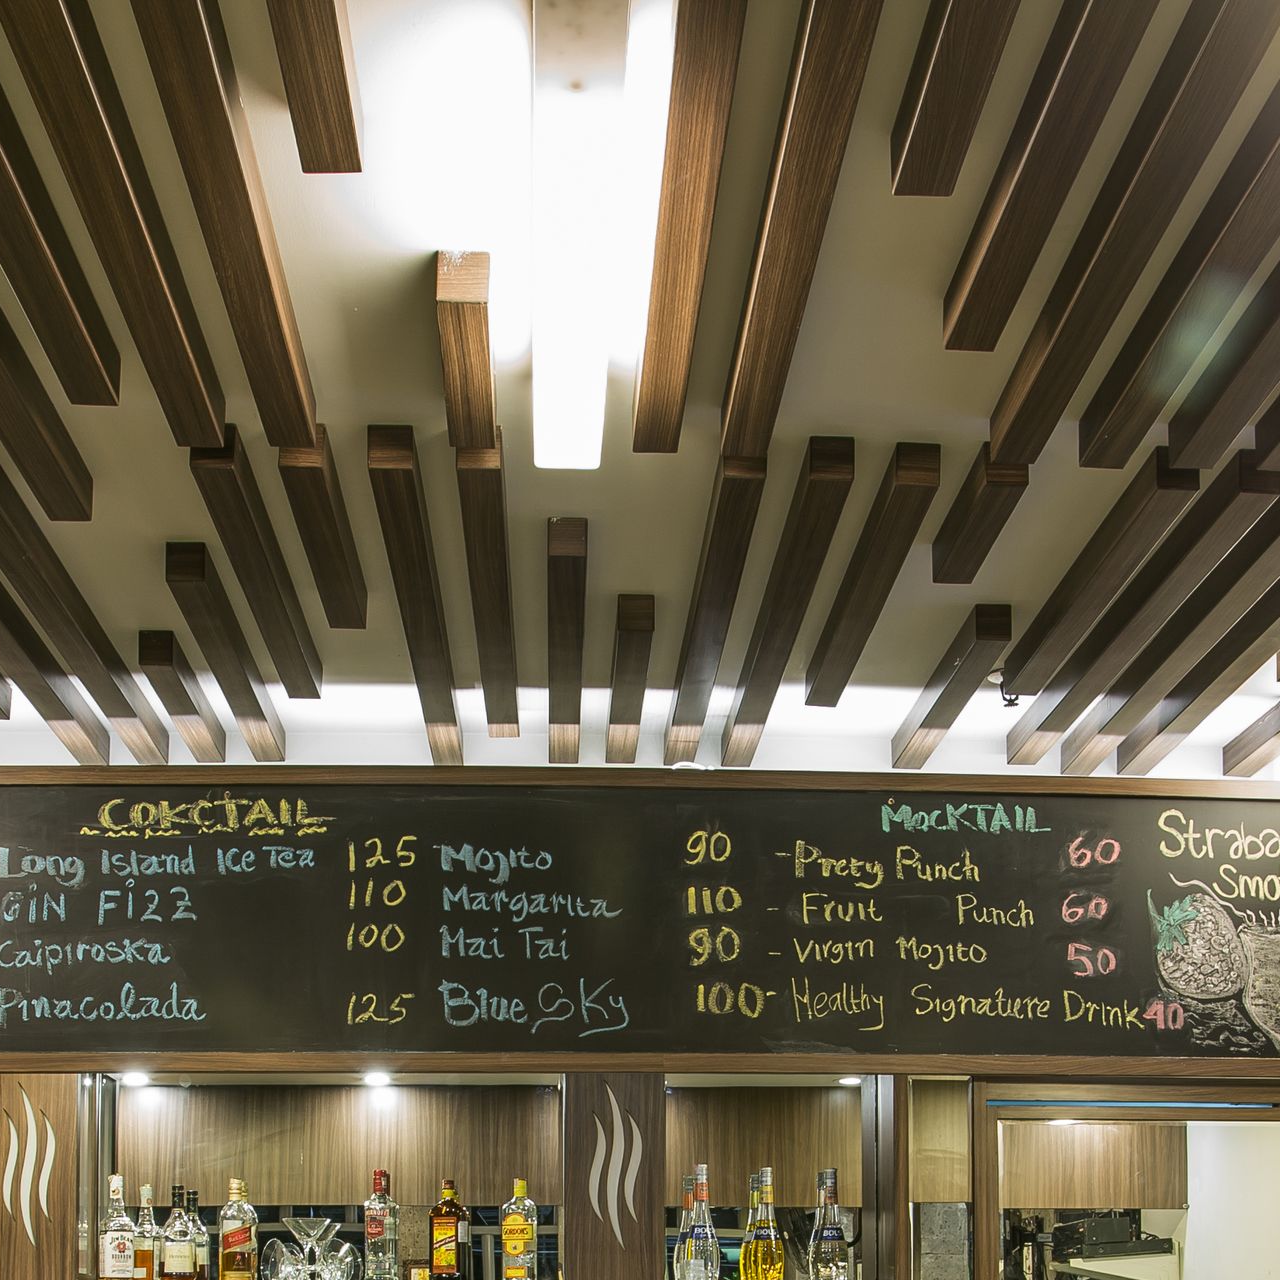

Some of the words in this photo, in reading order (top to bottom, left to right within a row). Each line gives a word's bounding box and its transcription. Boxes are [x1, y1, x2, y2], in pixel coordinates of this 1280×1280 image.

[97, 797, 337, 830] COKCTAIL
[100, 845, 196, 877] Island
[216, 847, 256, 875] Ice
[348, 835, 417, 873] 125
[438, 843, 553, 885] Mojito
[684, 829, 732, 866] 90
[896, 845, 980, 882] Punch
[1068, 835, 1121, 868] 60
[348, 877, 407, 910] 110
[442, 883, 624, 922] Margarita
[687, 885, 743, 915] 110
[802, 892, 883, 925] Fruit
[956, 894, 1035, 928] Punch
[1061, 893, 1109, 924] 60
[346, 922, 406, 952] 100
[439, 924, 505, 959] Mai
[518, 926, 570, 961] Tai
[688, 926, 741, 966] 90
[793, 937, 875, 965] Virgin
[897, 936, 988, 971] Mojito
[1067, 942, 1118, 978] 50
[346, 992, 415, 1025] 125
[438, 978, 529, 1027] Blue
[696, 981, 765, 1019] 100
[791, 976, 886, 1031] Healthy
[913, 983, 1051, 1022] Signature
[1063, 990, 1145, 1030] Drink
[1143, 1000, 1185, 1030] 40
